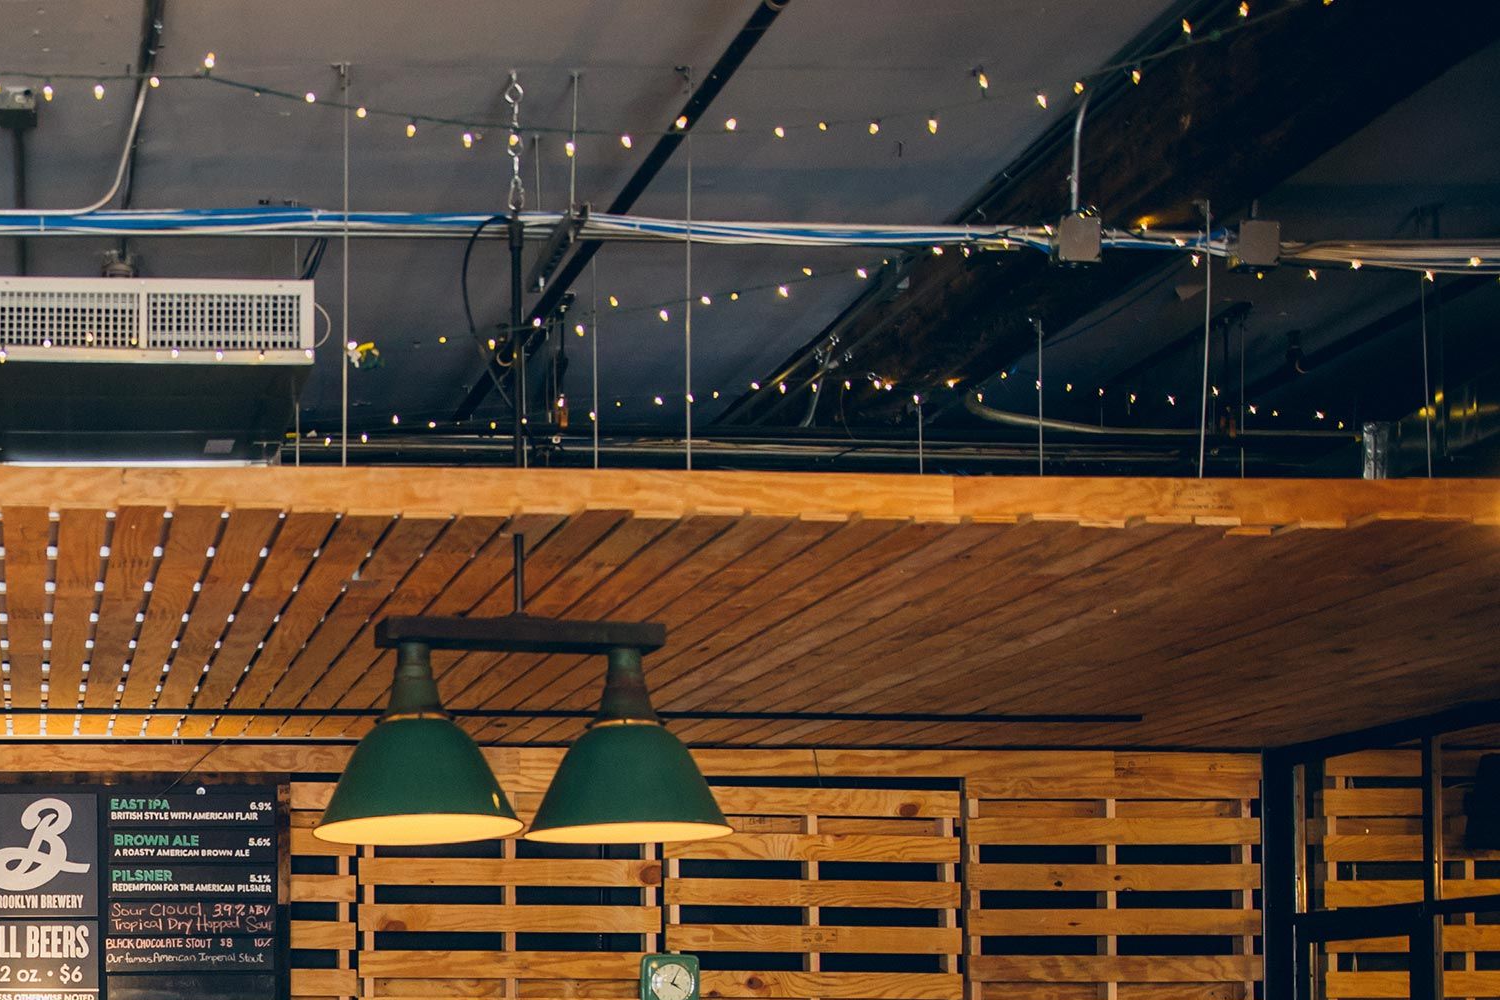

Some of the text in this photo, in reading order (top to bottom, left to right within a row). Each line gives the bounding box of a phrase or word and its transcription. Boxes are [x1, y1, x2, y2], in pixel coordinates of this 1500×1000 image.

[110, 799, 272, 810] EAST IPA 6.9%
[111, 812, 258, 820] BRITISH STYLE WITH AMERICAN FLAIR
[114, 834, 270, 846] BROWN ALE 5.6%
[112, 870, 172, 882] PILSNER
[112, 884, 272, 892] REDEMPTION FOR THE AMERICAN PILSNER
[41, 894, 84, 908] BREWERY
[112, 902, 270, 918] Sour Cloud 3.9% ABV
[112, 914, 273, 934] Tropical Dry Hopped Sour
[26, 925, 89, 958] BEERS
[106, 938, 272, 949] BLACK CHOCOLATE STOUT $8 10%
[106, 952, 264, 964] Our American Imperial Stout
[17, 968, 42, 982] oz.
[60, 964, 82, 984] $6
